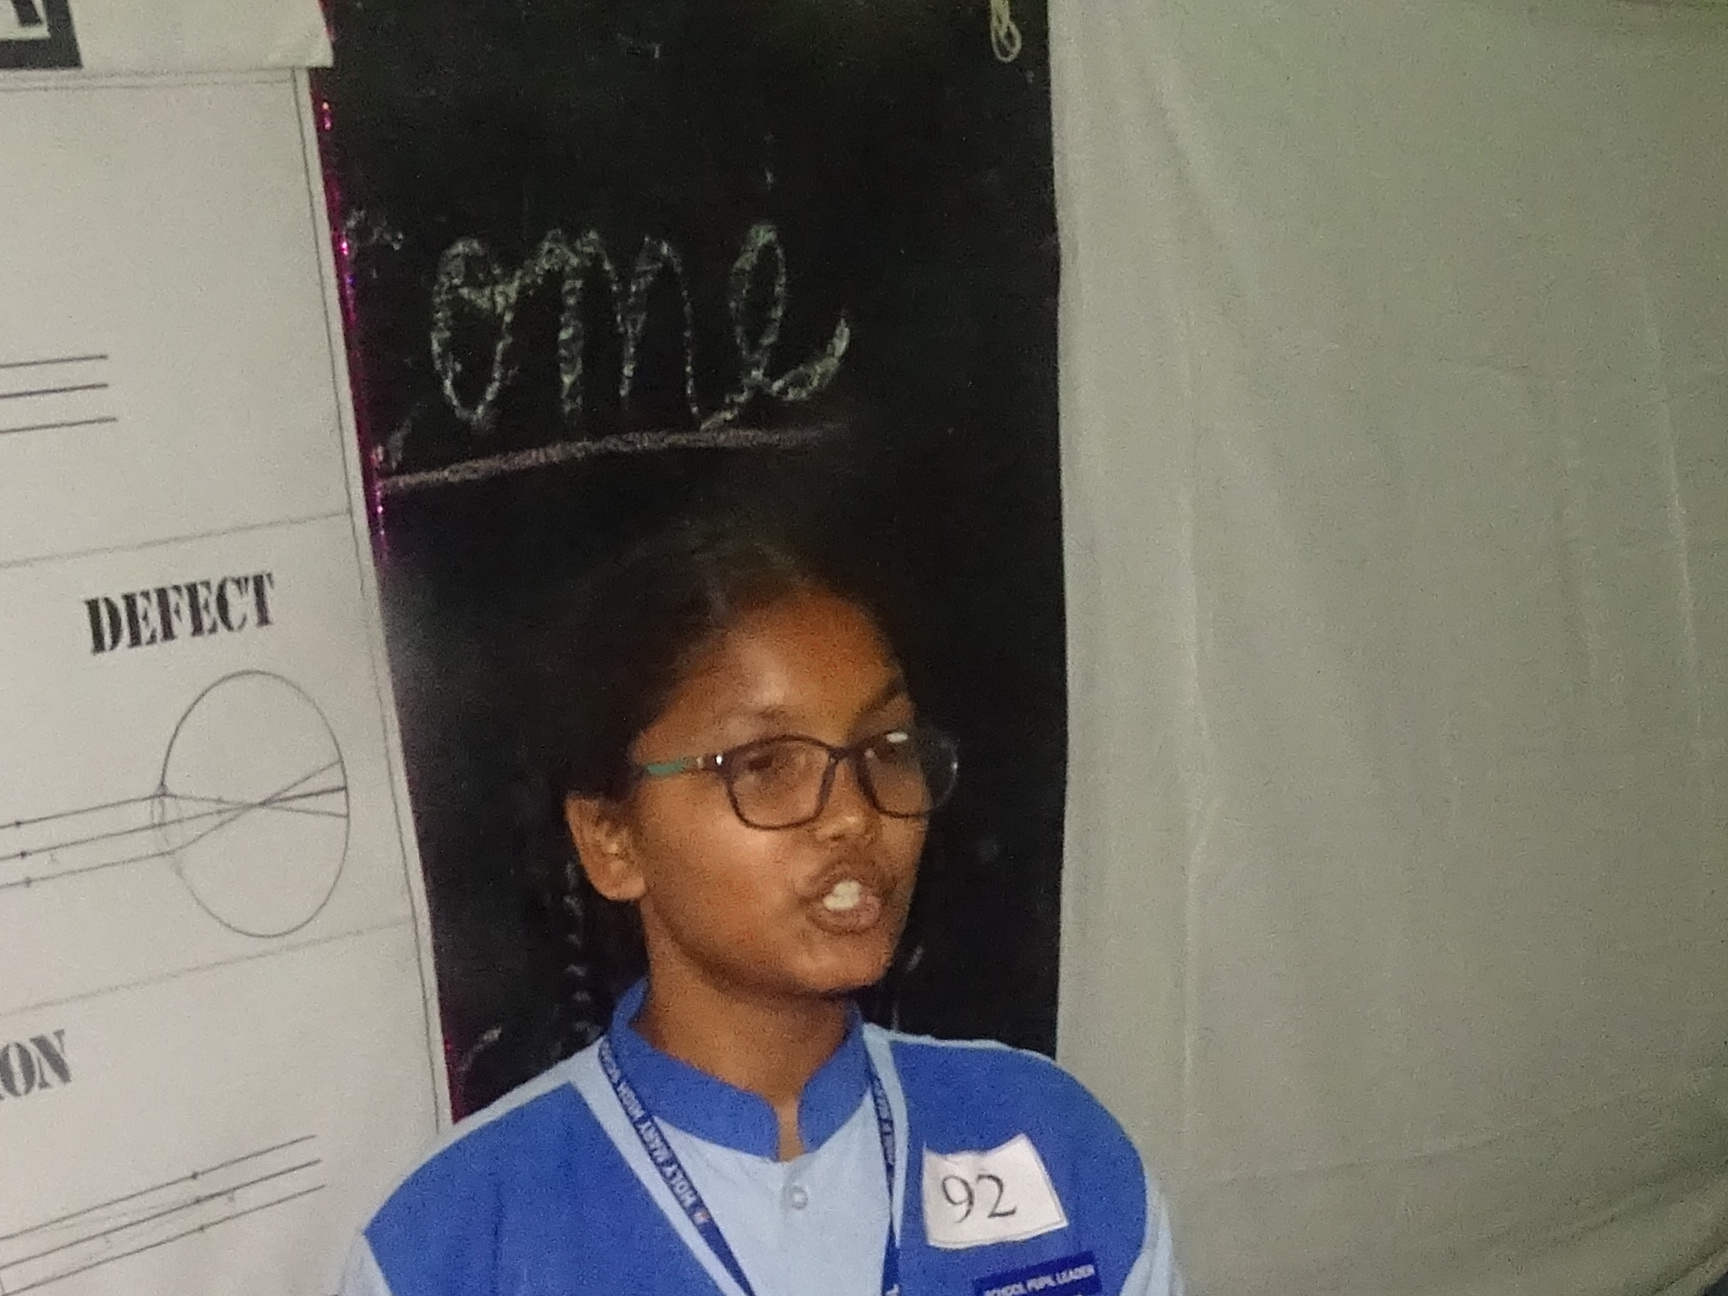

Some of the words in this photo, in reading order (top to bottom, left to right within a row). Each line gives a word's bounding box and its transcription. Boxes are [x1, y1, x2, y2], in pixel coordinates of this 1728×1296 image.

[84, 572, 275, 656] DEFECT
[638, 1120, 670, 1163] MARY
[662, 1164, 697, 1206] HOLY
[941, 1174, 1017, 1223] 92
